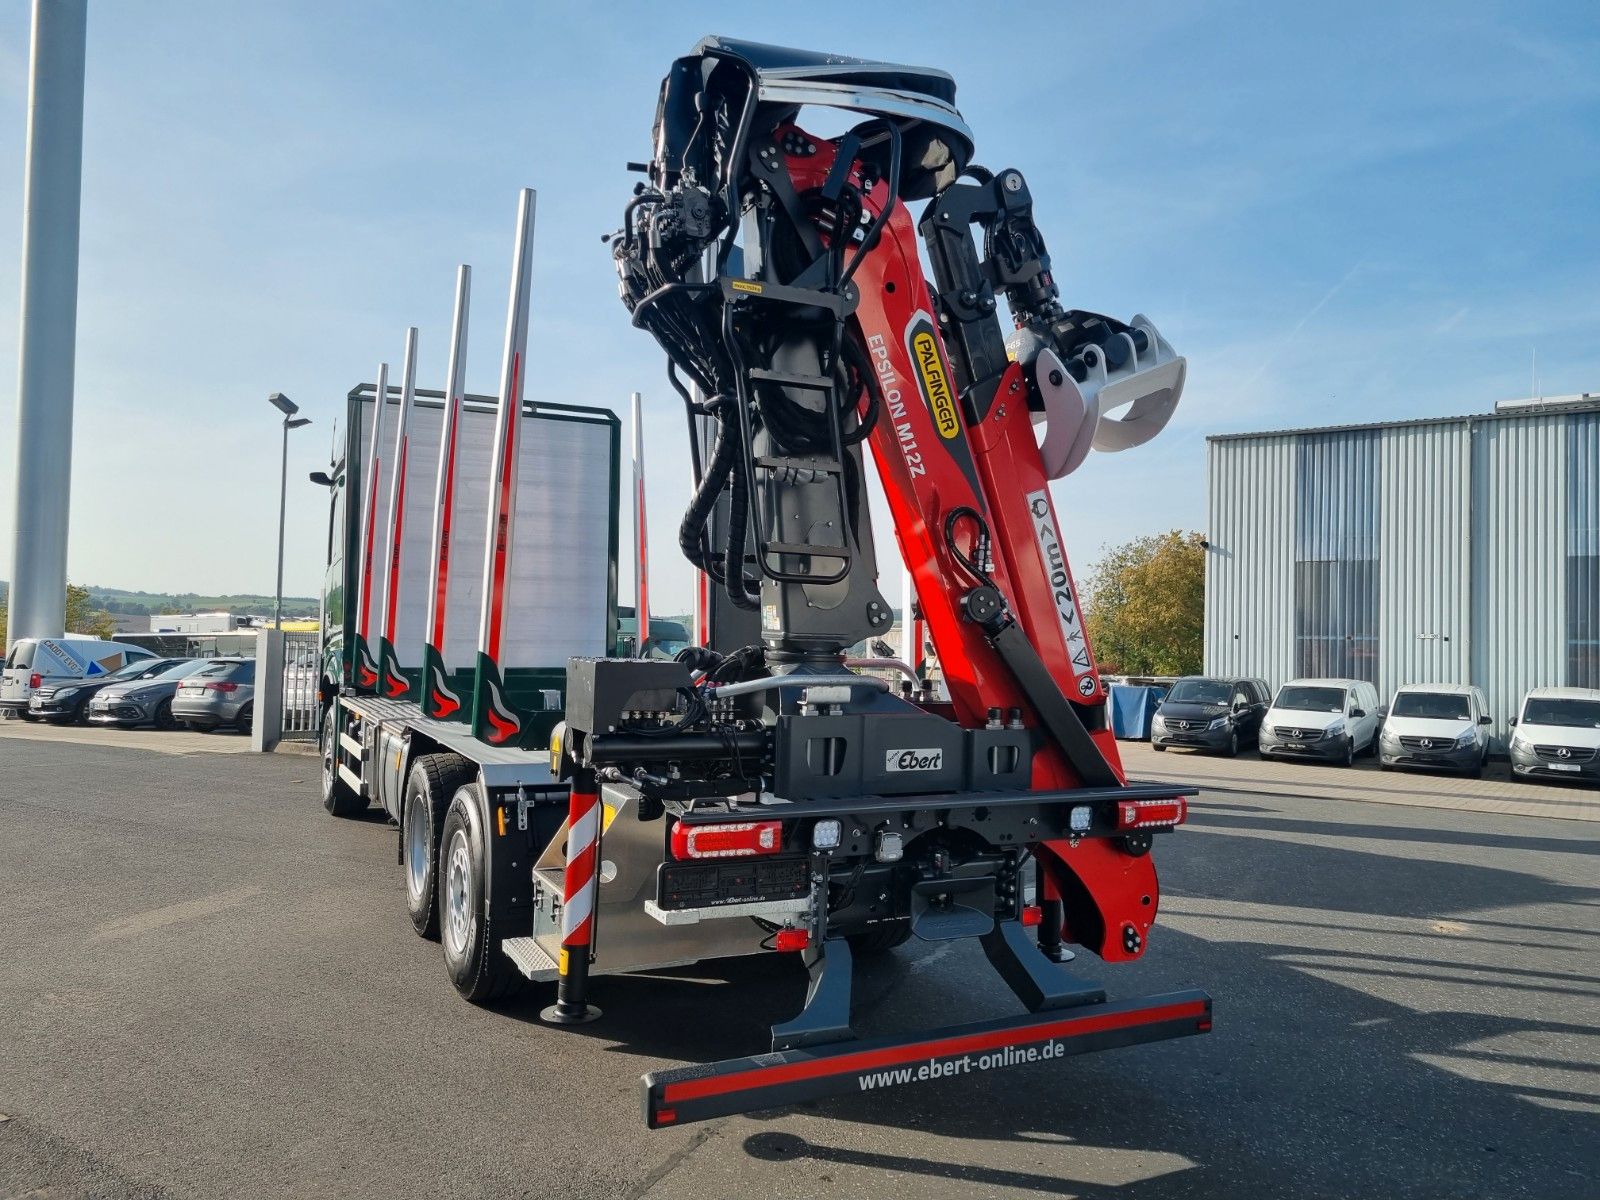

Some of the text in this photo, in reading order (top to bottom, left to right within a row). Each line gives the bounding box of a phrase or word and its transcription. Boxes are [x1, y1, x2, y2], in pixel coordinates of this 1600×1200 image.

[868, 334, 926, 479] EPSILON M12Z
[918, 338, 955, 432] PALFINGER
[44, 640, 66, 657] CADDY
[898, 751, 941, 770] Ebert
[859, 1039, 1065, 1091] www.ebert-online.de
